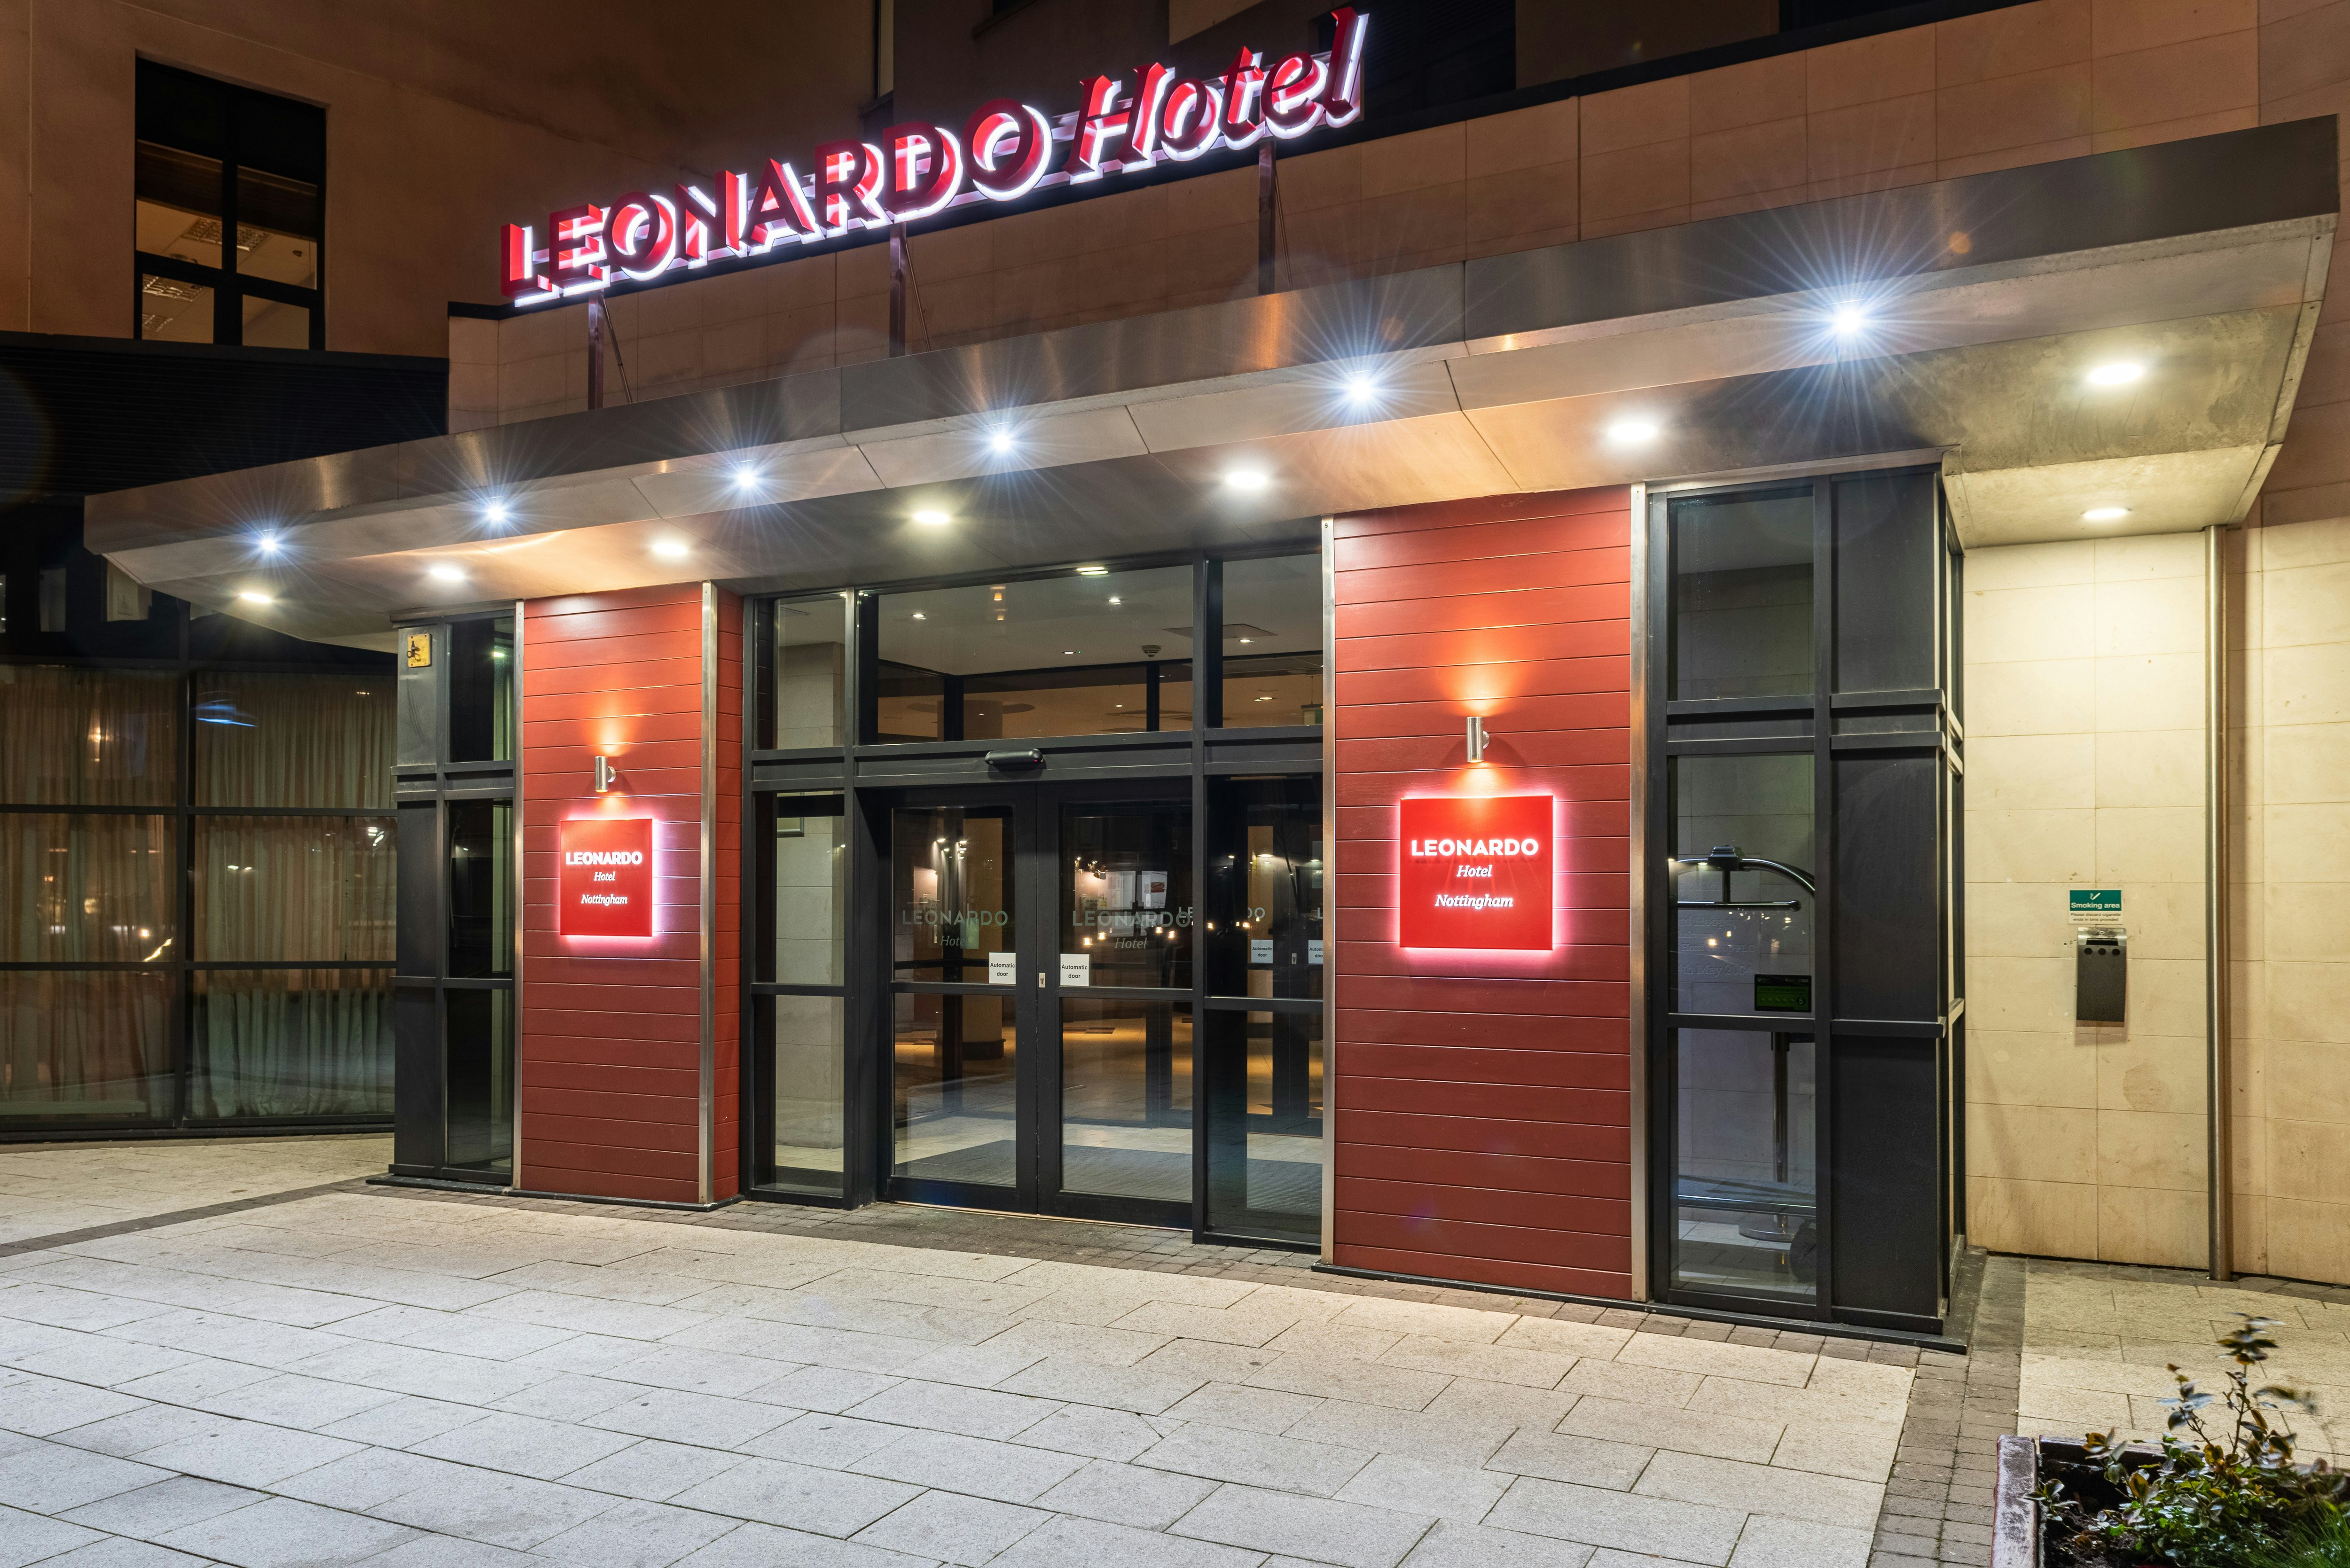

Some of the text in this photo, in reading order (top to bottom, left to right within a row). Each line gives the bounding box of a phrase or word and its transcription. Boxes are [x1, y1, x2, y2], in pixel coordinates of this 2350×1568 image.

[501, 6, 1369, 307] LEONARDO Hotel
[1411, 838, 1538, 856] LEONARDO
[565, 851, 642, 865] LEONARDO
[594, 871, 615, 881] Hotel
[1457, 865, 1492, 877] Hotel
[581, 894, 627, 906] Nottingham
[1434, 894, 1513, 910] Nottingham
[903, 910, 1008, 926] LEONARDO
[1073, 911, 1191, 928] LEONARDO
[940, 936, 966, 946] Hote
[1114, 937, 1147, 949] Hotel
